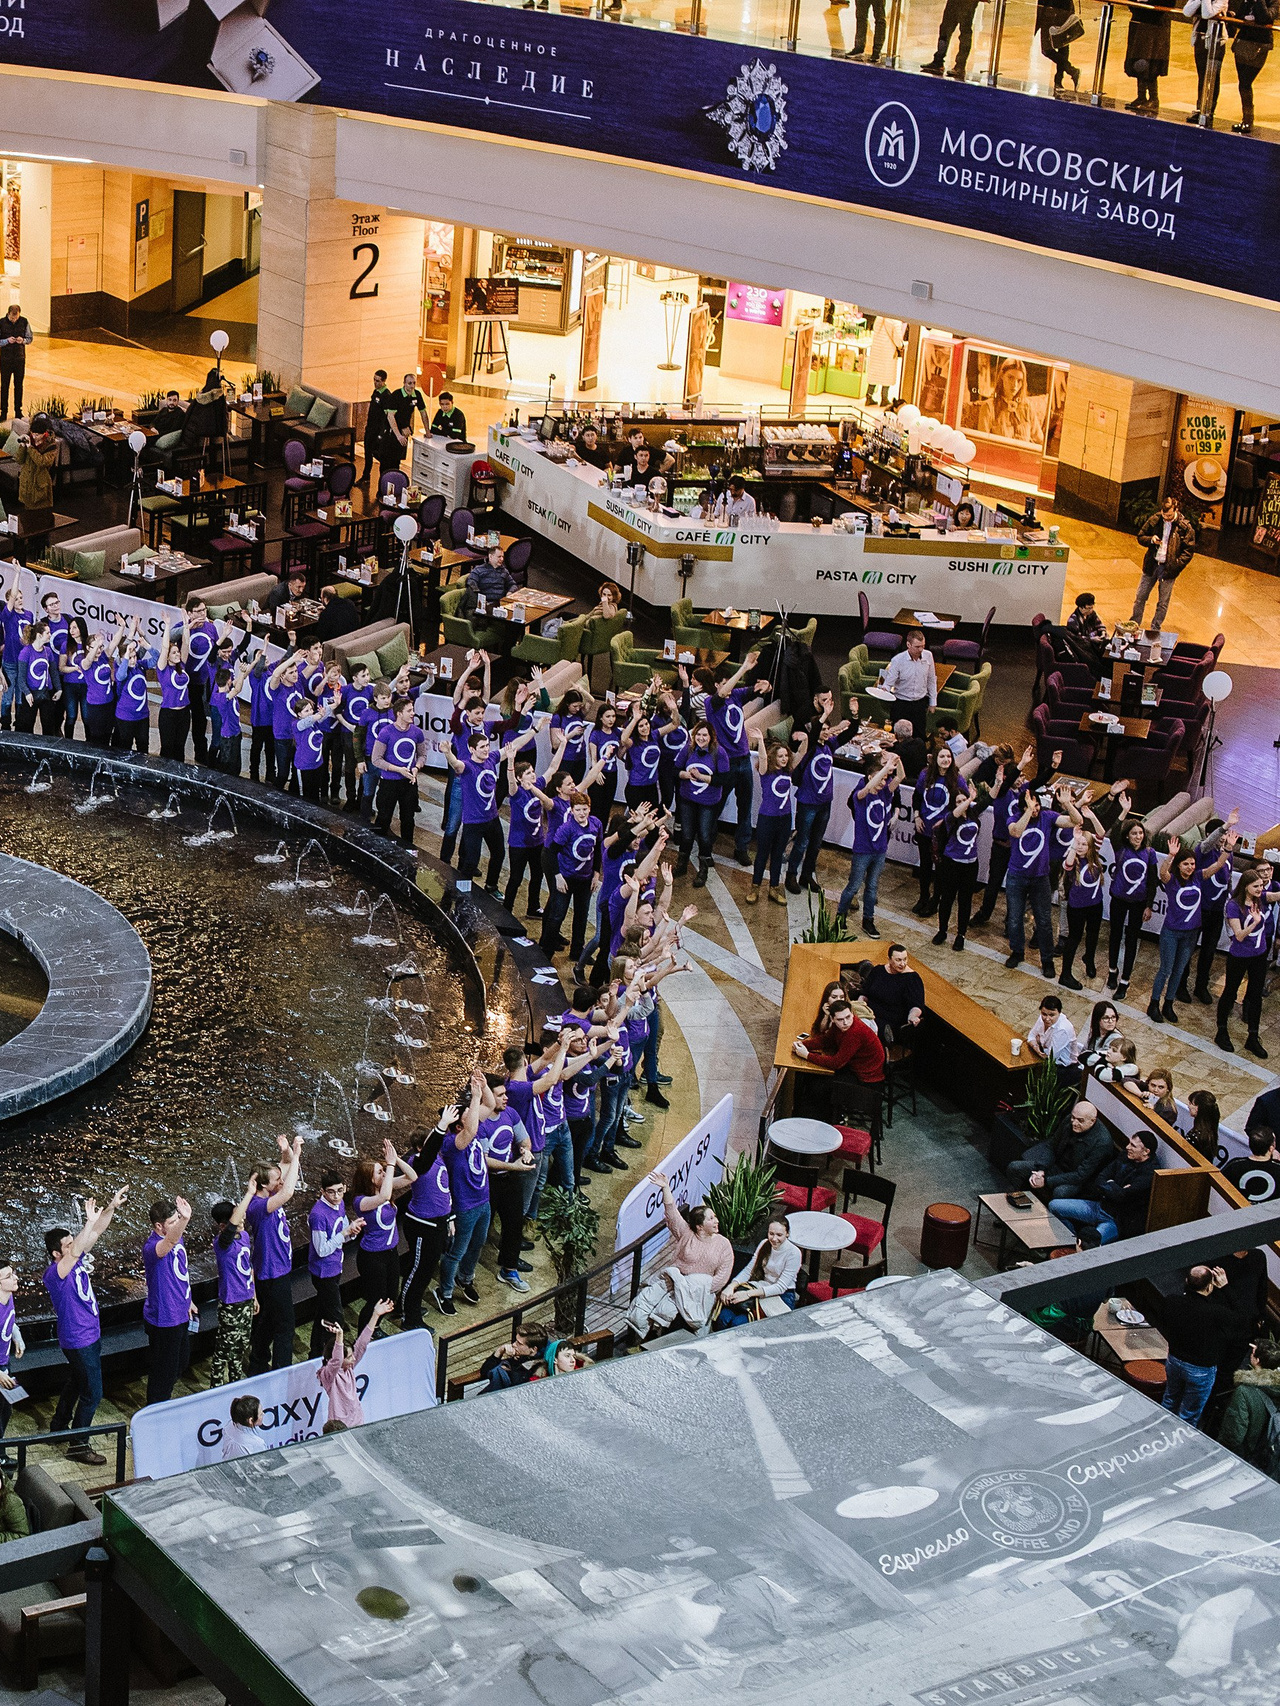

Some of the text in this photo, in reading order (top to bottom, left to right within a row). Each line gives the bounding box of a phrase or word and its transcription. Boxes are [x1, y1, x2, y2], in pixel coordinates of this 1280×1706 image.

[425, 27, 558, 57] ДРАГОЦЕННОЕ
[385, 48, 594, 99] НАСЛЕДИЕ
[883, 161, 898, 171] 1920
[940, 126, 1185, 204] МОСКОВСКИЙ
[139, 203, 147, 223] P
[351, 213, 380, 226] Этаж
[938, 163, 1176, 240] ЮВЕЛИРНЫЙ ЗАВОД
[352, 225, 379, 237] Floor
[349, 243, 380, 300] 2
[1187, 415, 1218, 429] КОФЕ
[1190, 425, 1227, 441] СОБОЙ
[1199, 441, 1212, 453] 99
[520, 464, 535, 479] CITY
[527, 499, 572, 534] STEAK CITY
[606, 499, 652, 534] SUSHI CITY
[675, 530, 771, 545] CAFÉ CITY
[816, 569, 917, 585] PASTA CITY
[948, 560, 1049, 576] SUSHI CITY
[189, 632, 213, 672] 9
[29, 657, 51, 691] 9
[94, 663, 112, 695] 9
[127, 673, 148, 712] 9
[170, 670, 190, 701] 9
[725, 703, 745, 744] 9
[308, 730, 324, 763] 9
[393, 737, 417, 771] 9
[641, 745, 662, 780] 9
[475, 769, 498, 811] 9
[810, 753, 834, 794] 9
[771, 775, 793, 810] 9
[923, 783, 951, 820] 9
[523, 797, 542, 836] 9
[866, 799, 886, 842] 9
[572, 833, 597, 871] 9
[956, 822, 979, 855] 9
[1019, 827, 1045, 868] 9
[1122, 858, 1147, 895] 9
[1175, 886, 1202, 923] 9
[468, 1137, 487, 1188] 9
[489, 1125, 515, 1163] 9
[646, 1154, 693, 1219] Gaaxy
[695, 1133, 711, 1166] S9
[277, 1207, 293, 1260] 9
[375, 1201, 397, 1246] 9
[173, 1243, 192, 1300] 9
[236, 1246, 253, 1290] 9
[74, 1265, 99, 1316] 9
[966, 1471, 1028, 1502] STARBUCKS
[992, 1493, 1085, 1550] COFFEE AND TEA
[878, 1527, 969, 1576] Espresso
[928, 1636, 1130, 1706] STARBUCKS
